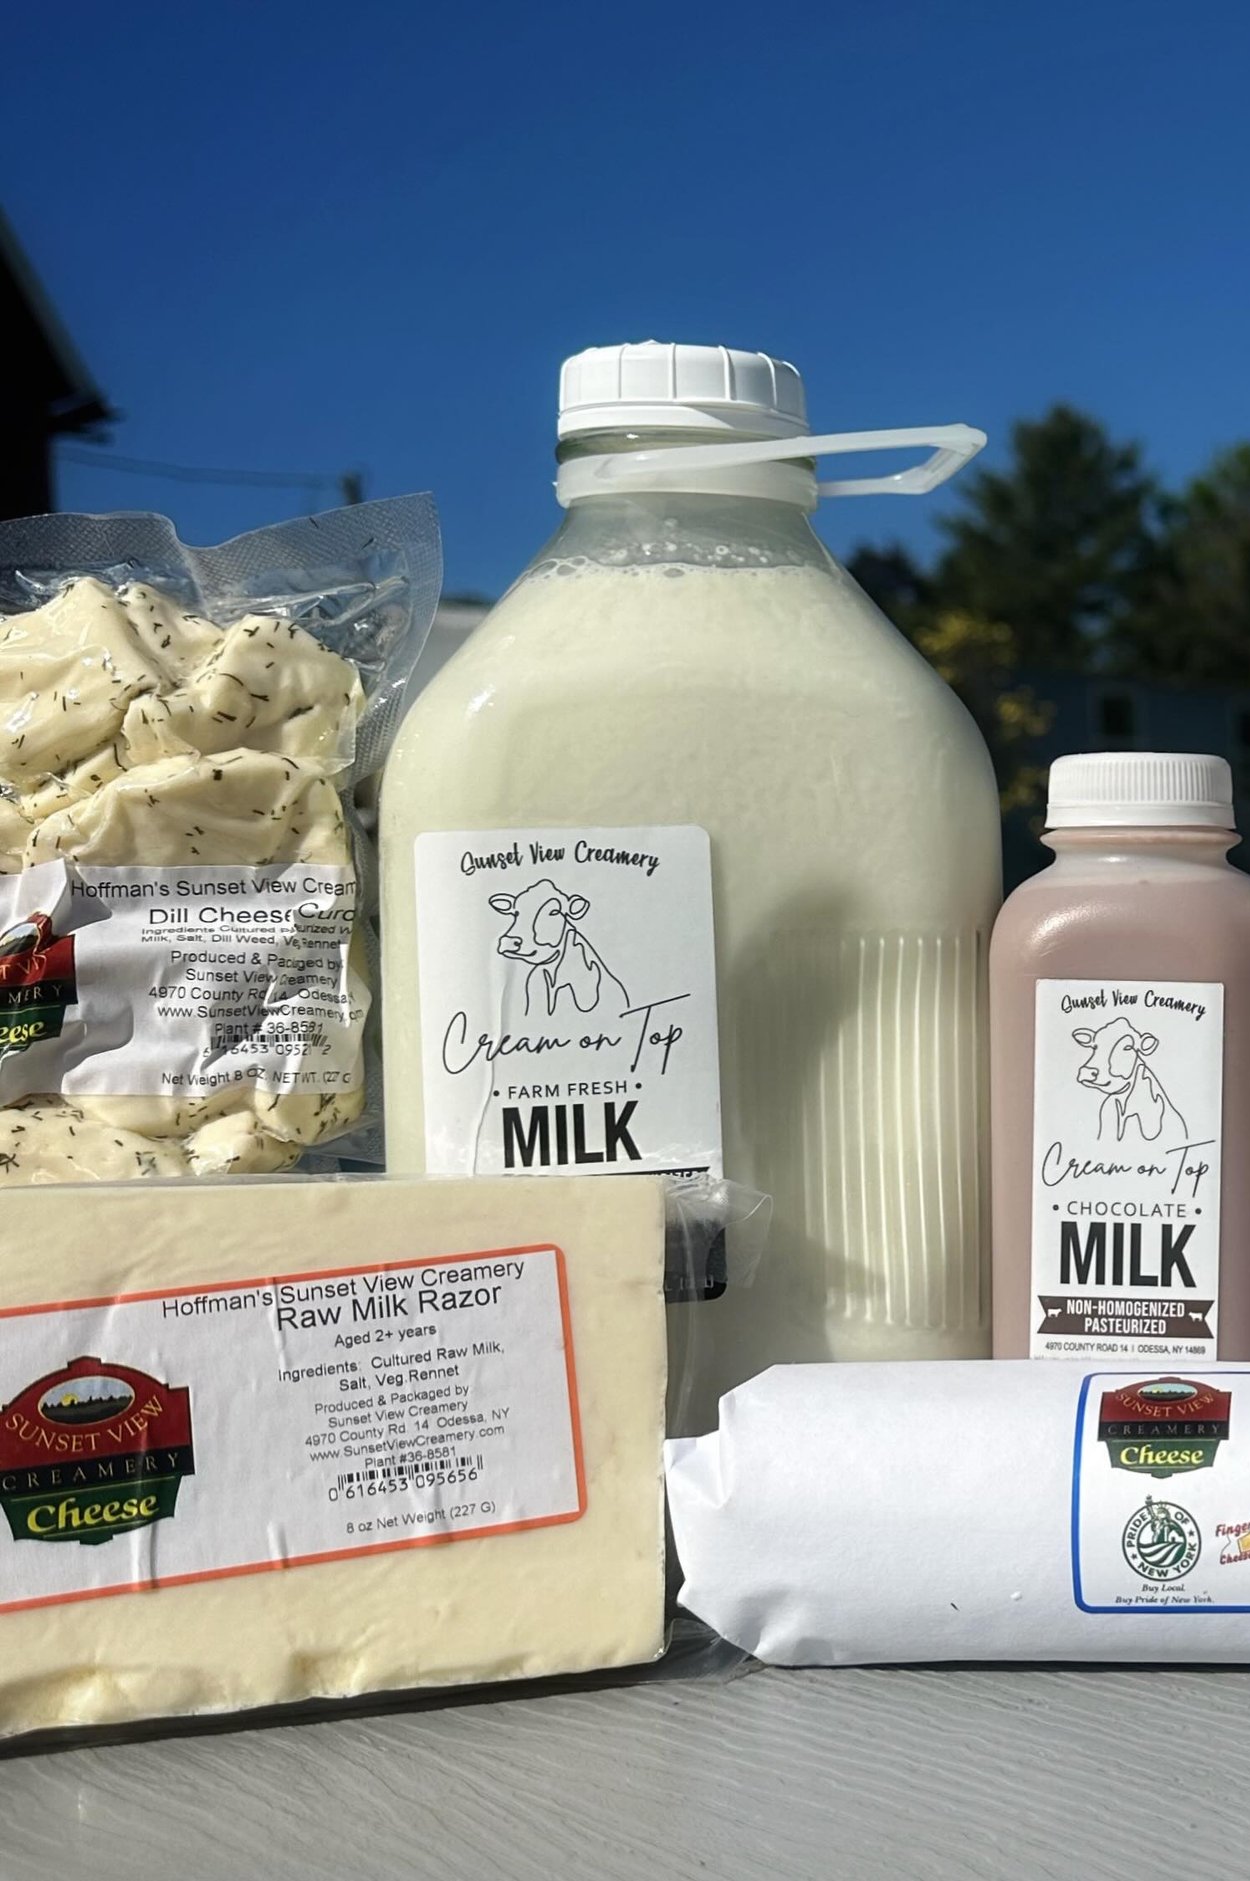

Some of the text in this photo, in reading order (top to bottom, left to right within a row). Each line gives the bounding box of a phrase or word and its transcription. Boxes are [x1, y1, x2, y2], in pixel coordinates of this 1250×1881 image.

[460, 840, 660, 876] Sunset View Creamery
[71, 880, 169, 898] Hoffman's
[177, 879, 247, 896] Sunset
[252, 878, 296, 894] View
[150, 908, 188, 925] Dill
[1061, 989, 1206, 1021] Sunset View Creamery
[442, 993, 691, 1075] Cream on Top
[508, 1081, 628, 1099] FARM FRESH
[502, 1100, 642, 1168] MILK
[1042, 1139, 1216, 1198] Cream on Top
[1067, 1201, 1187, 1217] CHOCOLATE
[1060, 1221, 1197, 1288] MILK
[162, 1261, 524, 1318] Hoffman's Sunset View Creamery
[277, 1285, 502, 1331] Raw Milk Razor
[1066, 1300, 1185, 1317] NON-HOMOGENIZED
[334, 1325, 437, 1349] Aged 2+ years
[1084, 1318, 1166, 1334] PASTEURIZED
[370, 1351, 431, 1369] Cultured
[436, 1347, 468, 1361] Raw
[472, 1341, 504, 1355] Milk,
[340, 1377, 371, 1391] Salt,
[1116, 1393, 1214, 1417] SUNSET VIEW
[5, 1395, 163, 1452] SUNSET VIEW
[1108, 1424, 1220, 1435] CREAMERY
[365, 1446, 456, 1469] Plant #36-8581
[1120, 1444, 1204, 1465] Cheese
[2, 1452, 179, 1492] CREAMERY
[27, 1494, 159, 1533] Cheese
[1127, 1511, 1189, 1548] PRIDE OF
[1137, 1542, 1197, 1578] NEW YORK
